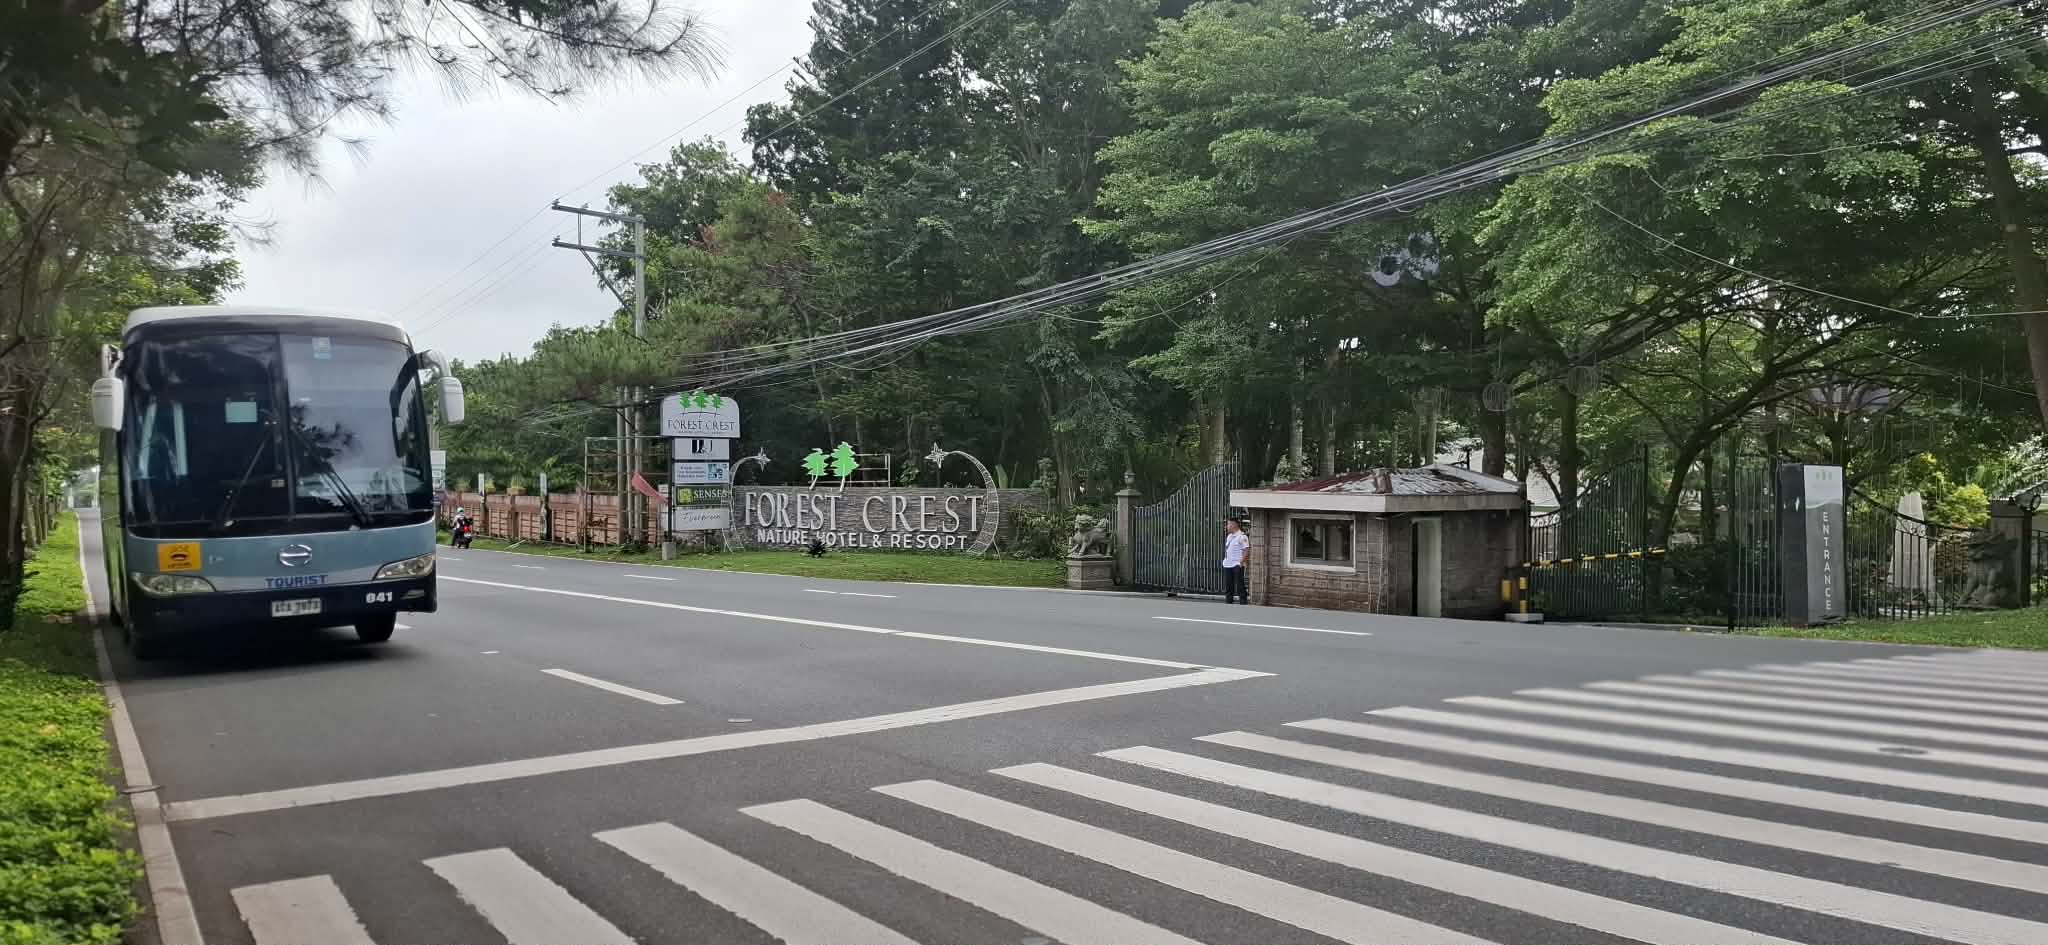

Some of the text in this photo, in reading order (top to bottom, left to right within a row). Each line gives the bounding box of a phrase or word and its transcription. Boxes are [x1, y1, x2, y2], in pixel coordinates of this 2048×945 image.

[667, 419, 736, 431] FOREST CREST
[745, 491, 984, 533] FOREST CREST
[757, 529, 809, 545] NATURE
[816, 531, 867, 548] HOTEL
[872, 533, 882, 548] &
[1822, 511, 1832, 611] ENTRANCE
[264, 574, 328, 589] TOURIST
